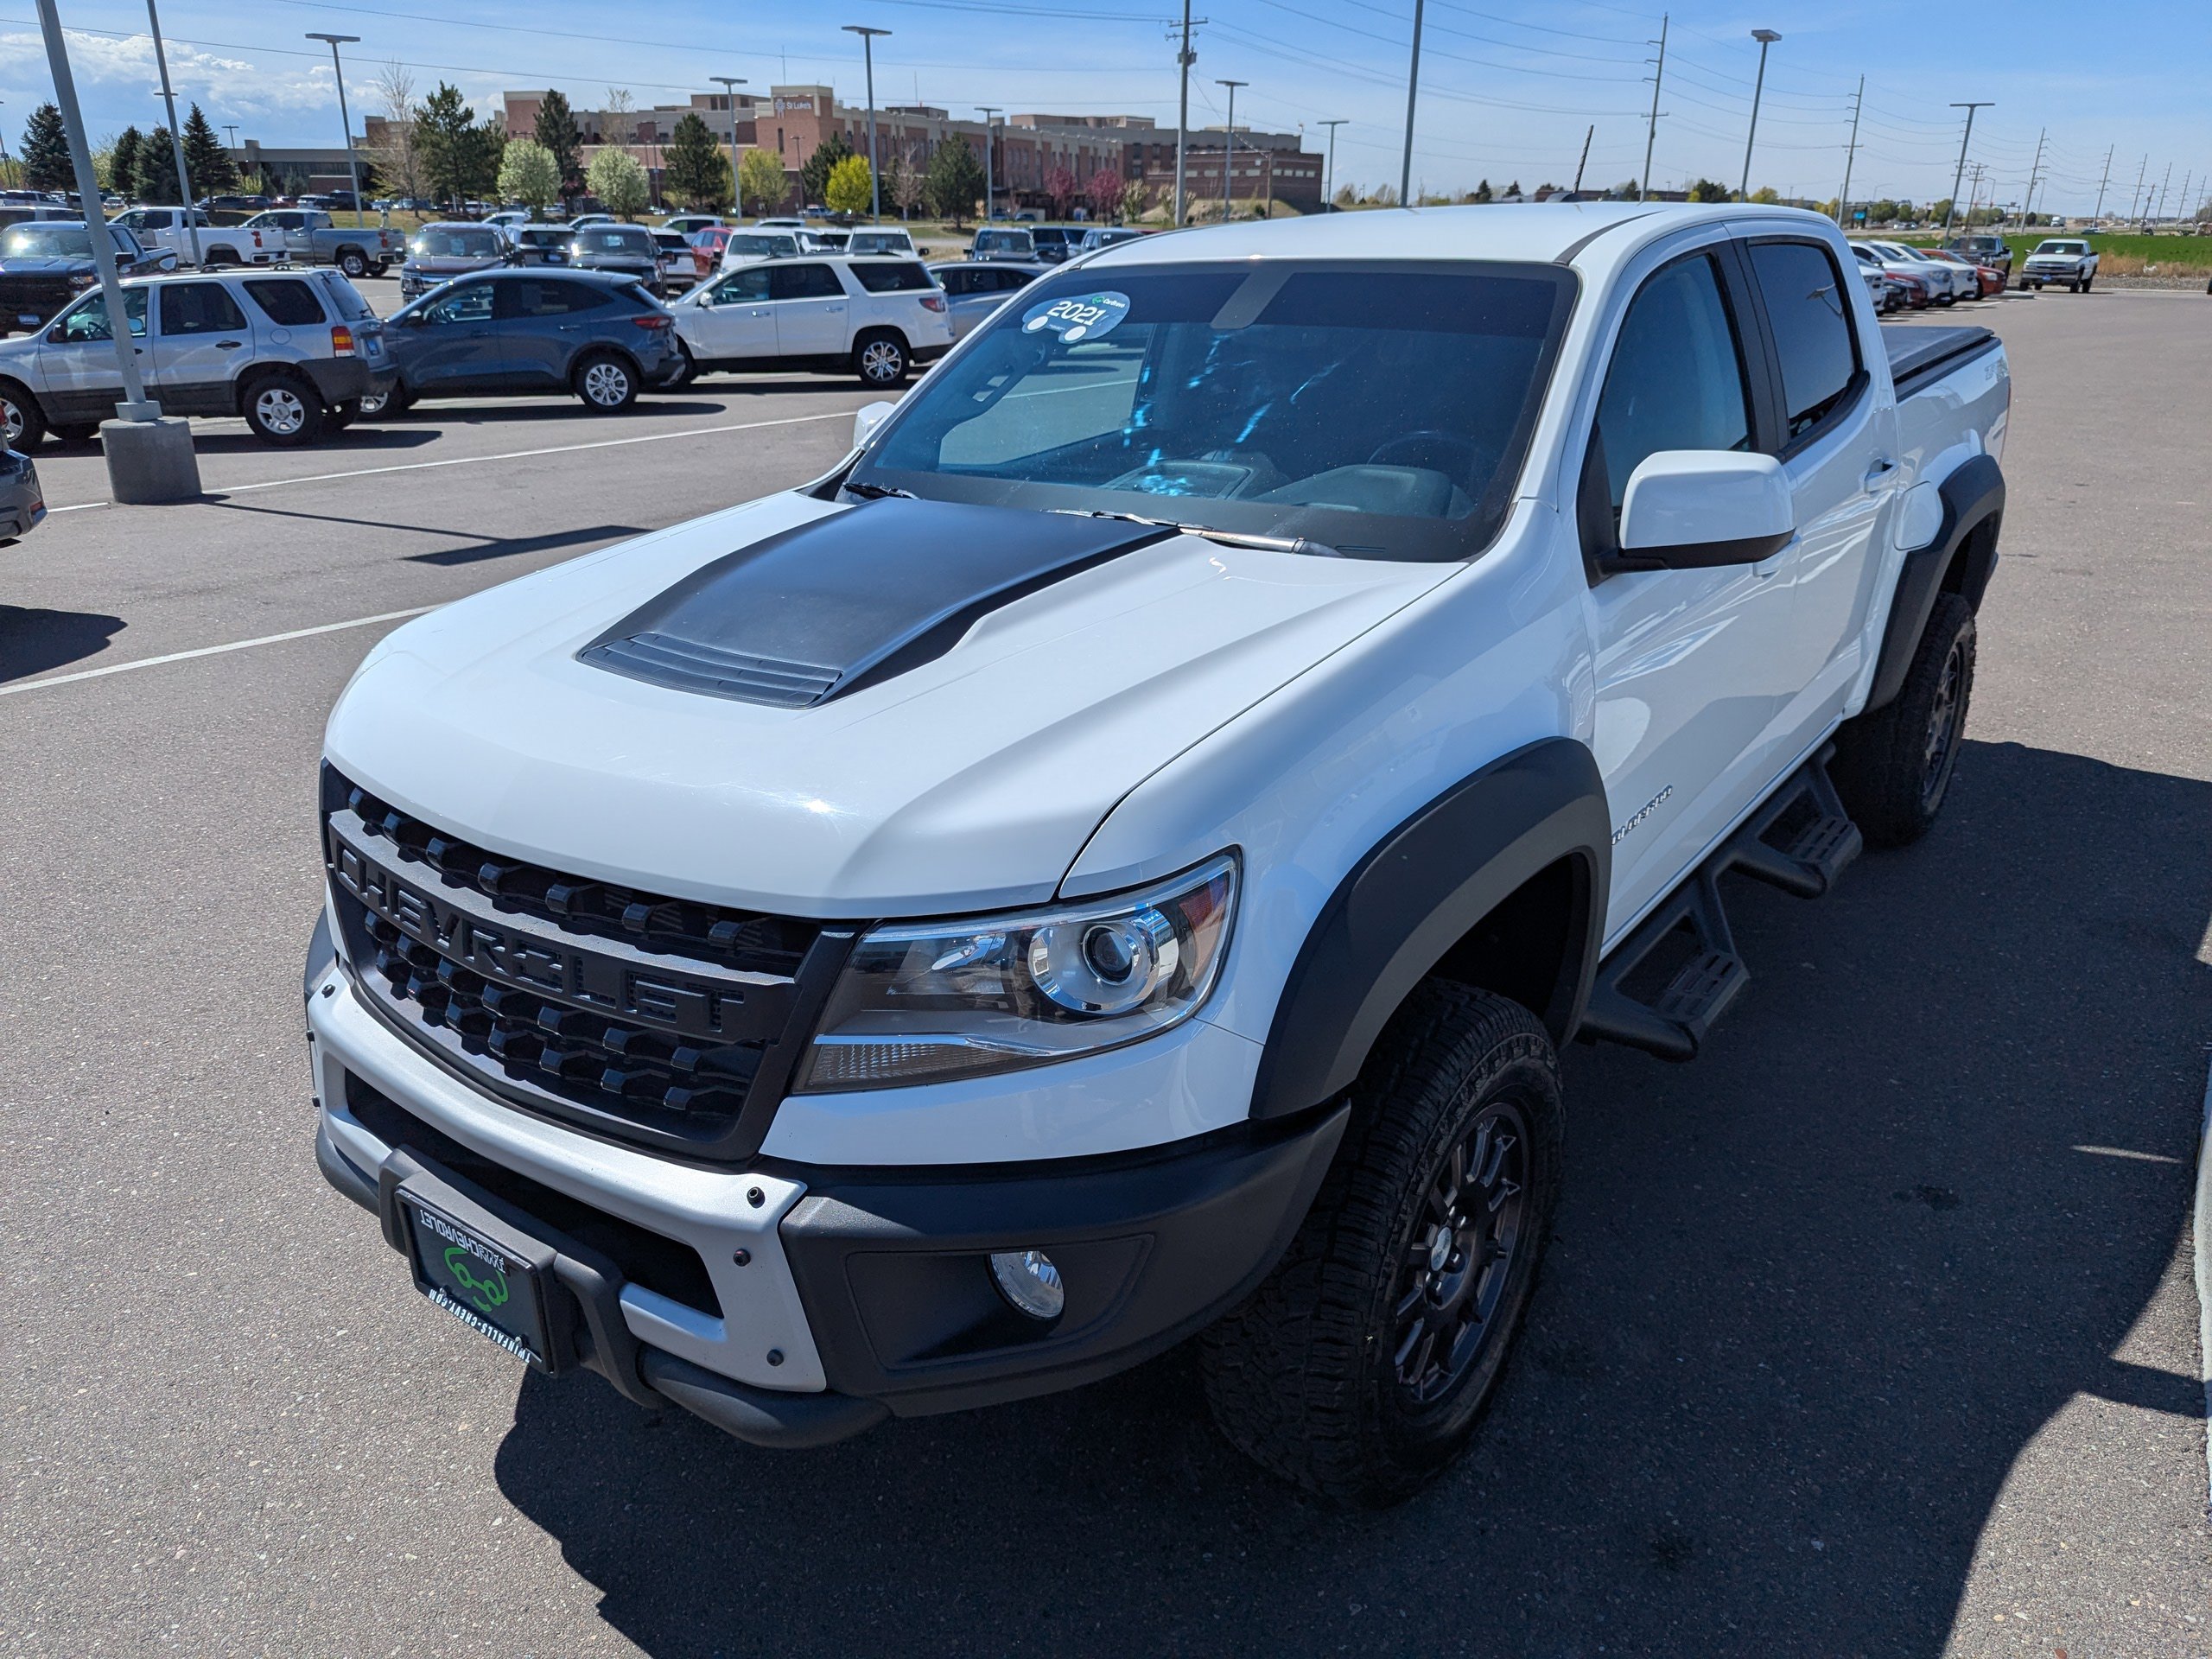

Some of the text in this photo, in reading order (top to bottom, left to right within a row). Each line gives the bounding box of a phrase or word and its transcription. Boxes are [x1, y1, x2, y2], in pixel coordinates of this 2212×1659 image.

[1046, 301, 1107, 326] 2021
[1611, 785, 1673, 845] OLORADO
[338, 846, 746, 1033] CHEVROLET
[419, 1209, 480, 1258] CHEVROLET
[428, 1288, 531, 1363] TWINFALLS-CHEVY.COM
